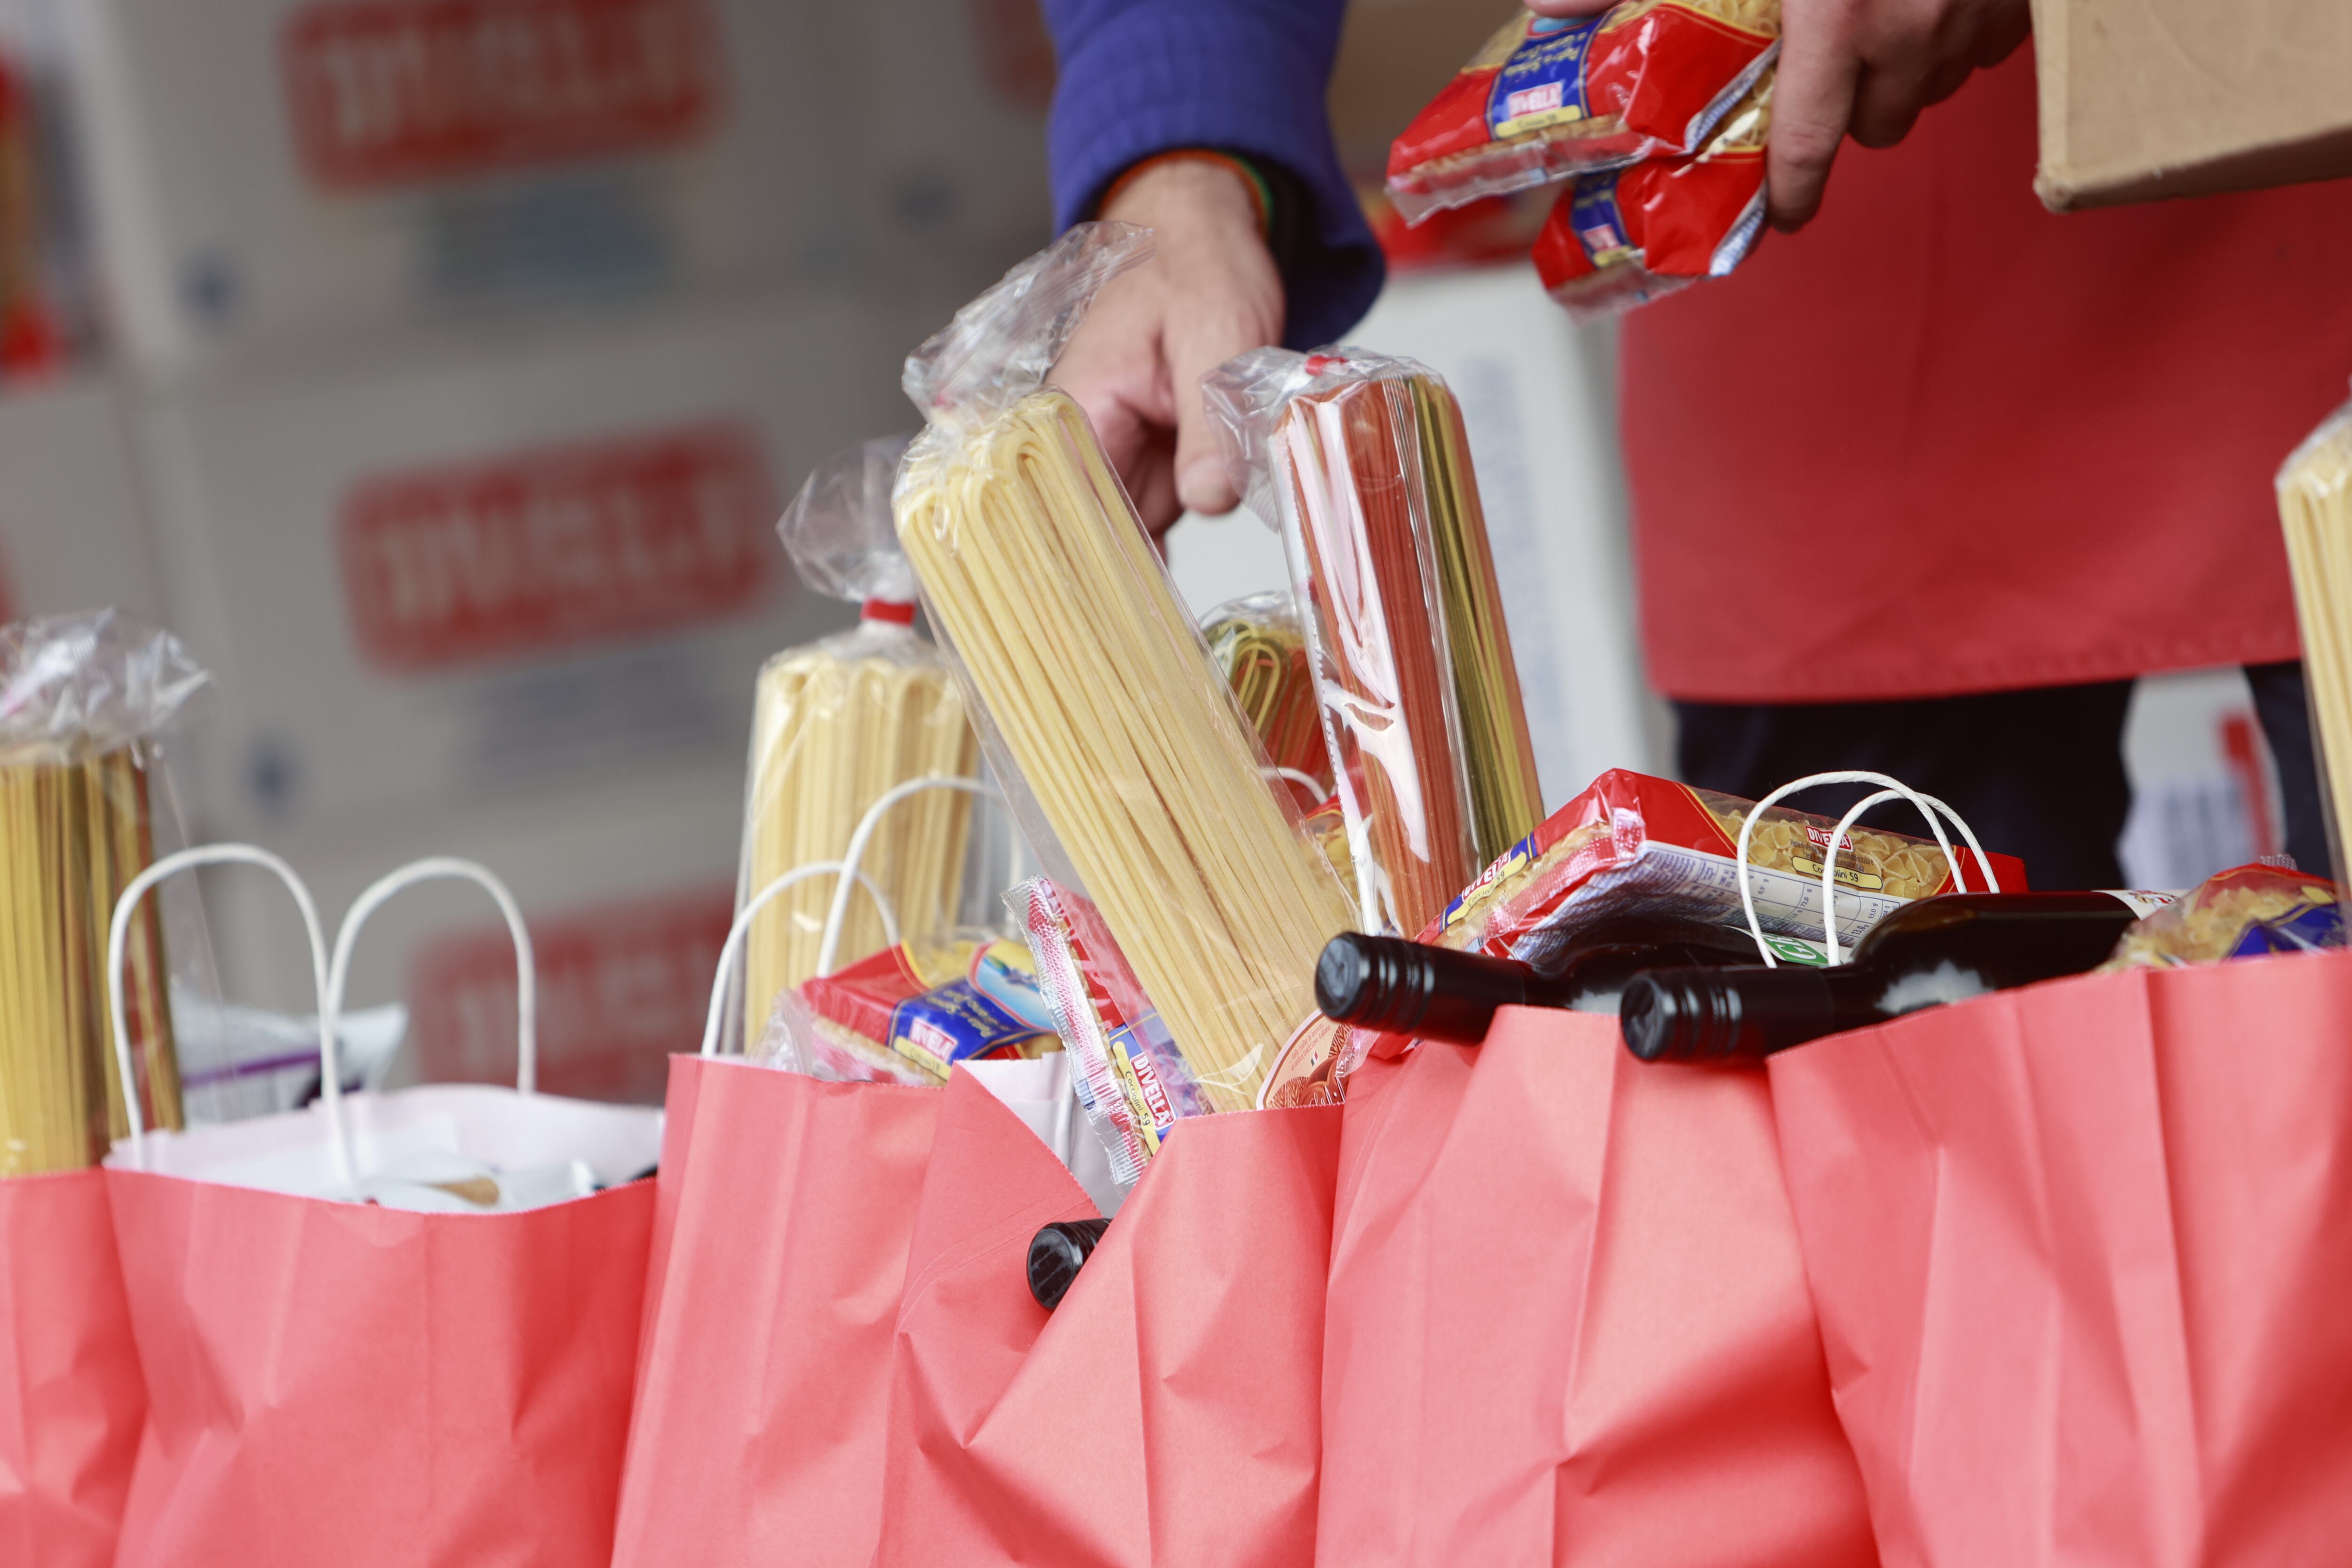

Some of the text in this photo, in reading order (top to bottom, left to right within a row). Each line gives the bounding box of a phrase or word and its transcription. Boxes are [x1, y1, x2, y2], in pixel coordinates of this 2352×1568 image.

[1807, 828, 1851, 848] DIVEA
[1812, 864, 1848, 879] Coolini
[1850, 872, 1859, 882] 59
[1800, 897, 1810, 907] 72,0
[1125, 1071, 1151, 1126] Cocciolini 59
[1134, 1055, 1170, 1126] DIVELLA
